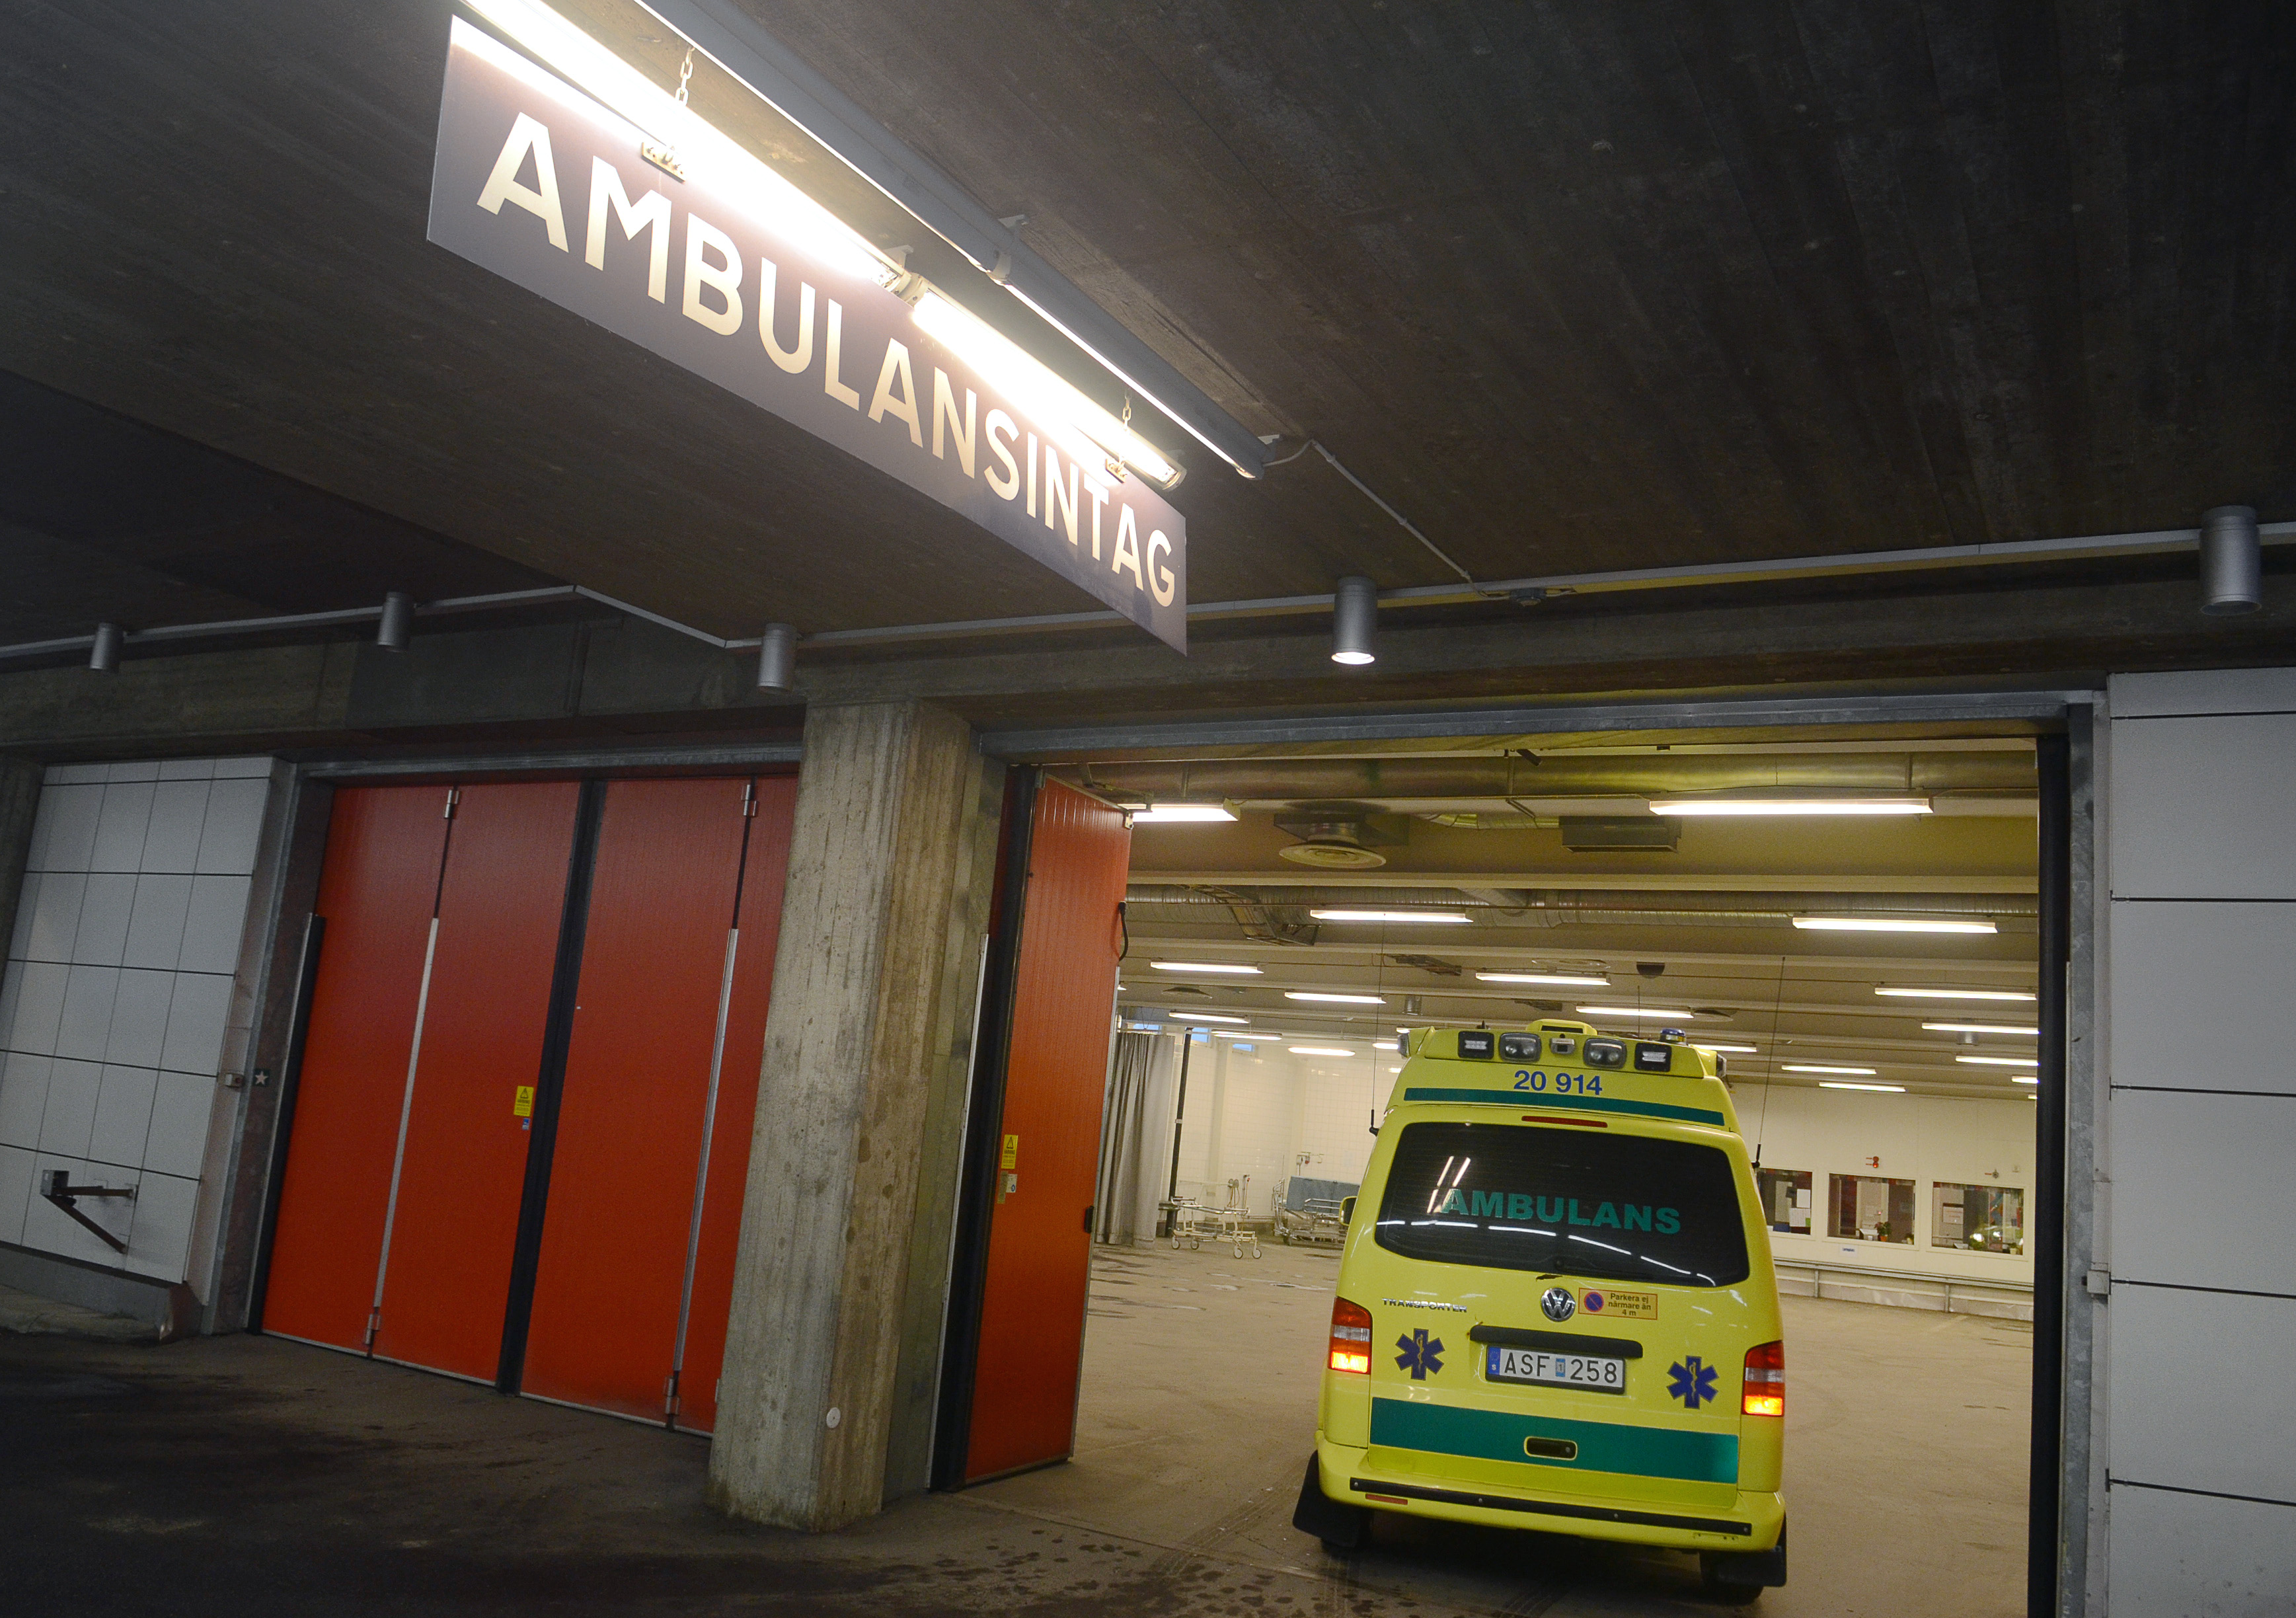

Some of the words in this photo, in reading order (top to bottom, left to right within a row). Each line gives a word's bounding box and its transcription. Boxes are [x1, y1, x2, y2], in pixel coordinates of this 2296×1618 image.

[477, 111, 1176, 609] AMBULANSINTAG
[1513, 1069, 1547, 1091] 20
[1555, 1072, 1603, 1095] 914
[1439, 1188, 1681, 1234] AMBULANS
[1381, 1297, 1467, 1313] TRANSPORTER
[1608, 1300, 1640, 1310] närmare
[1642, 1301, 1652, 1311] än
[1610, 1293, 1640, 1302] Parkera
[1642, 1295, 1649, 1304] ej
[1504, 1352, 1550, 1377] ASF
[1570, 1358, 1617, 1383] 258
